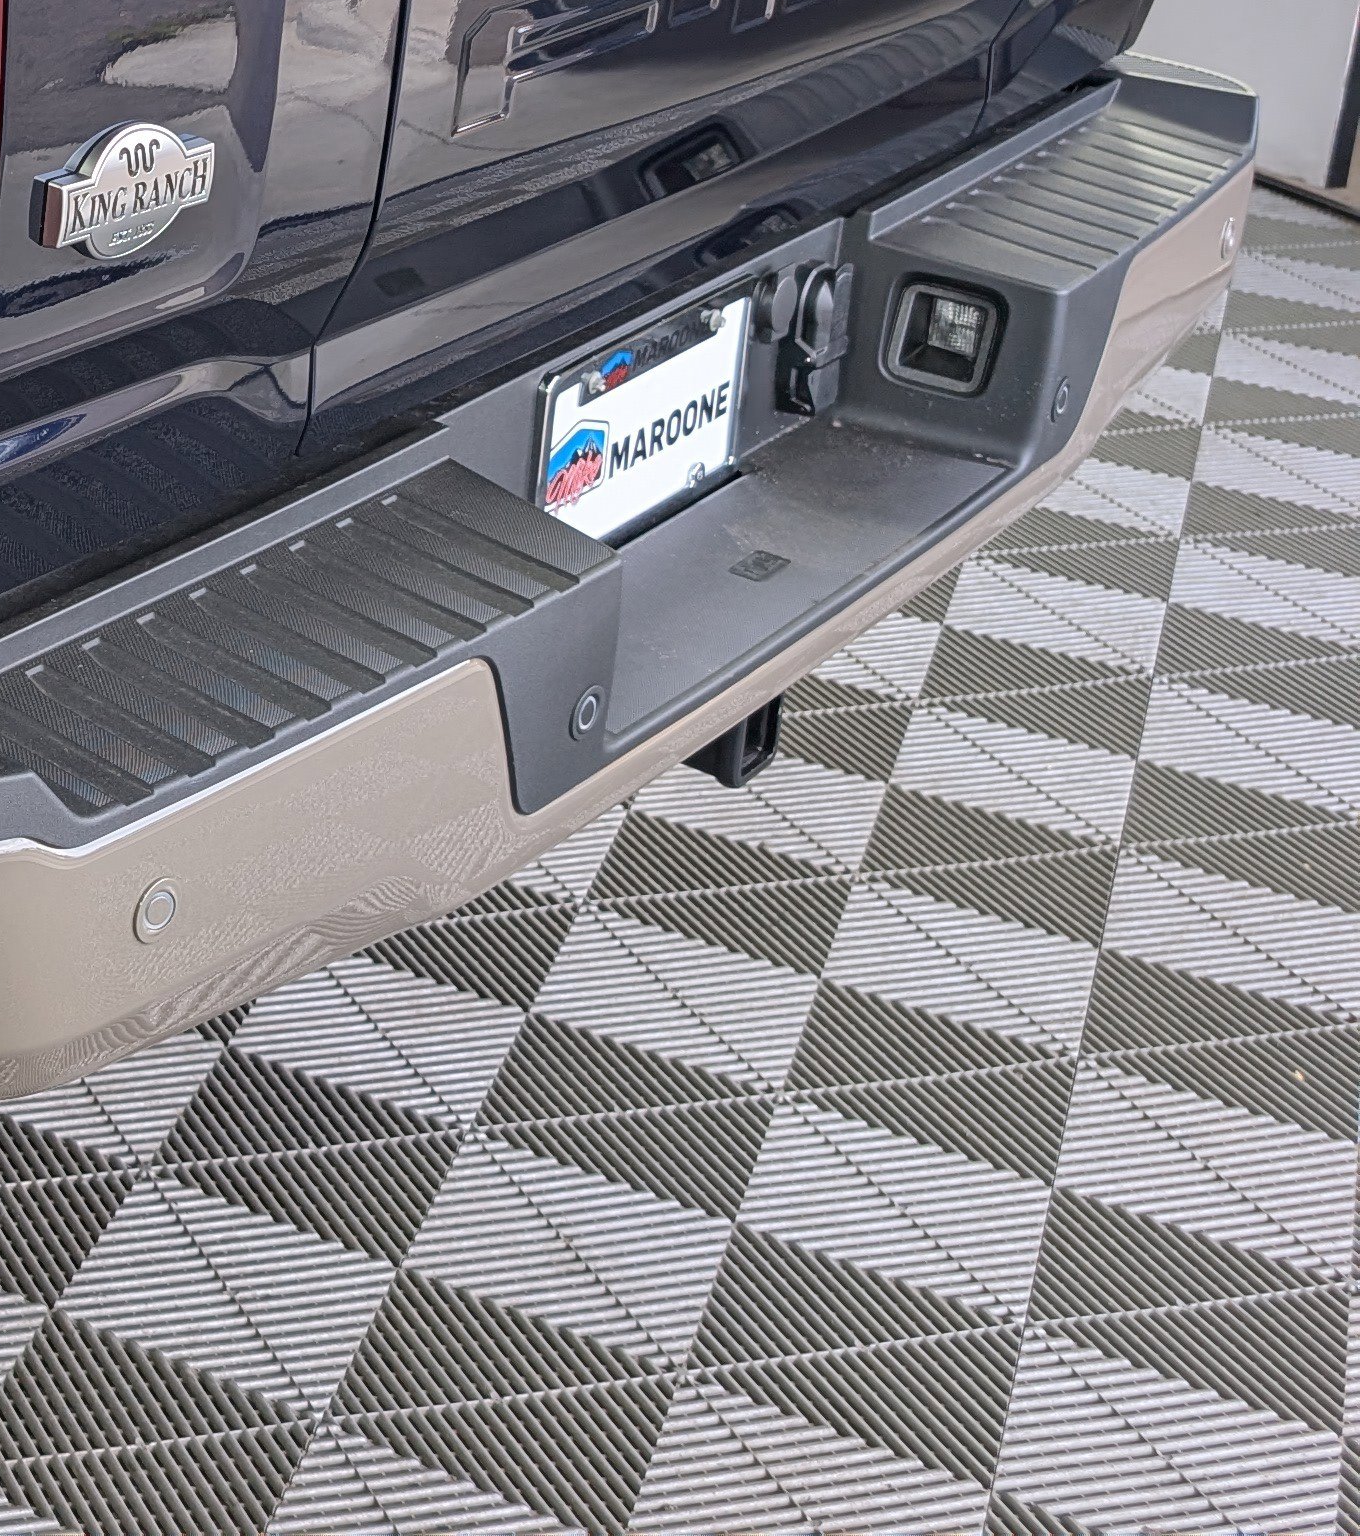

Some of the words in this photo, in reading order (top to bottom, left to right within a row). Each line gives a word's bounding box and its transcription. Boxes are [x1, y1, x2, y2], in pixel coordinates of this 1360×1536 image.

[70, 186, 127, 235] KING
[132, 157, 210, 214] RANCH
[608, 380, 730, 479] MAROONE
